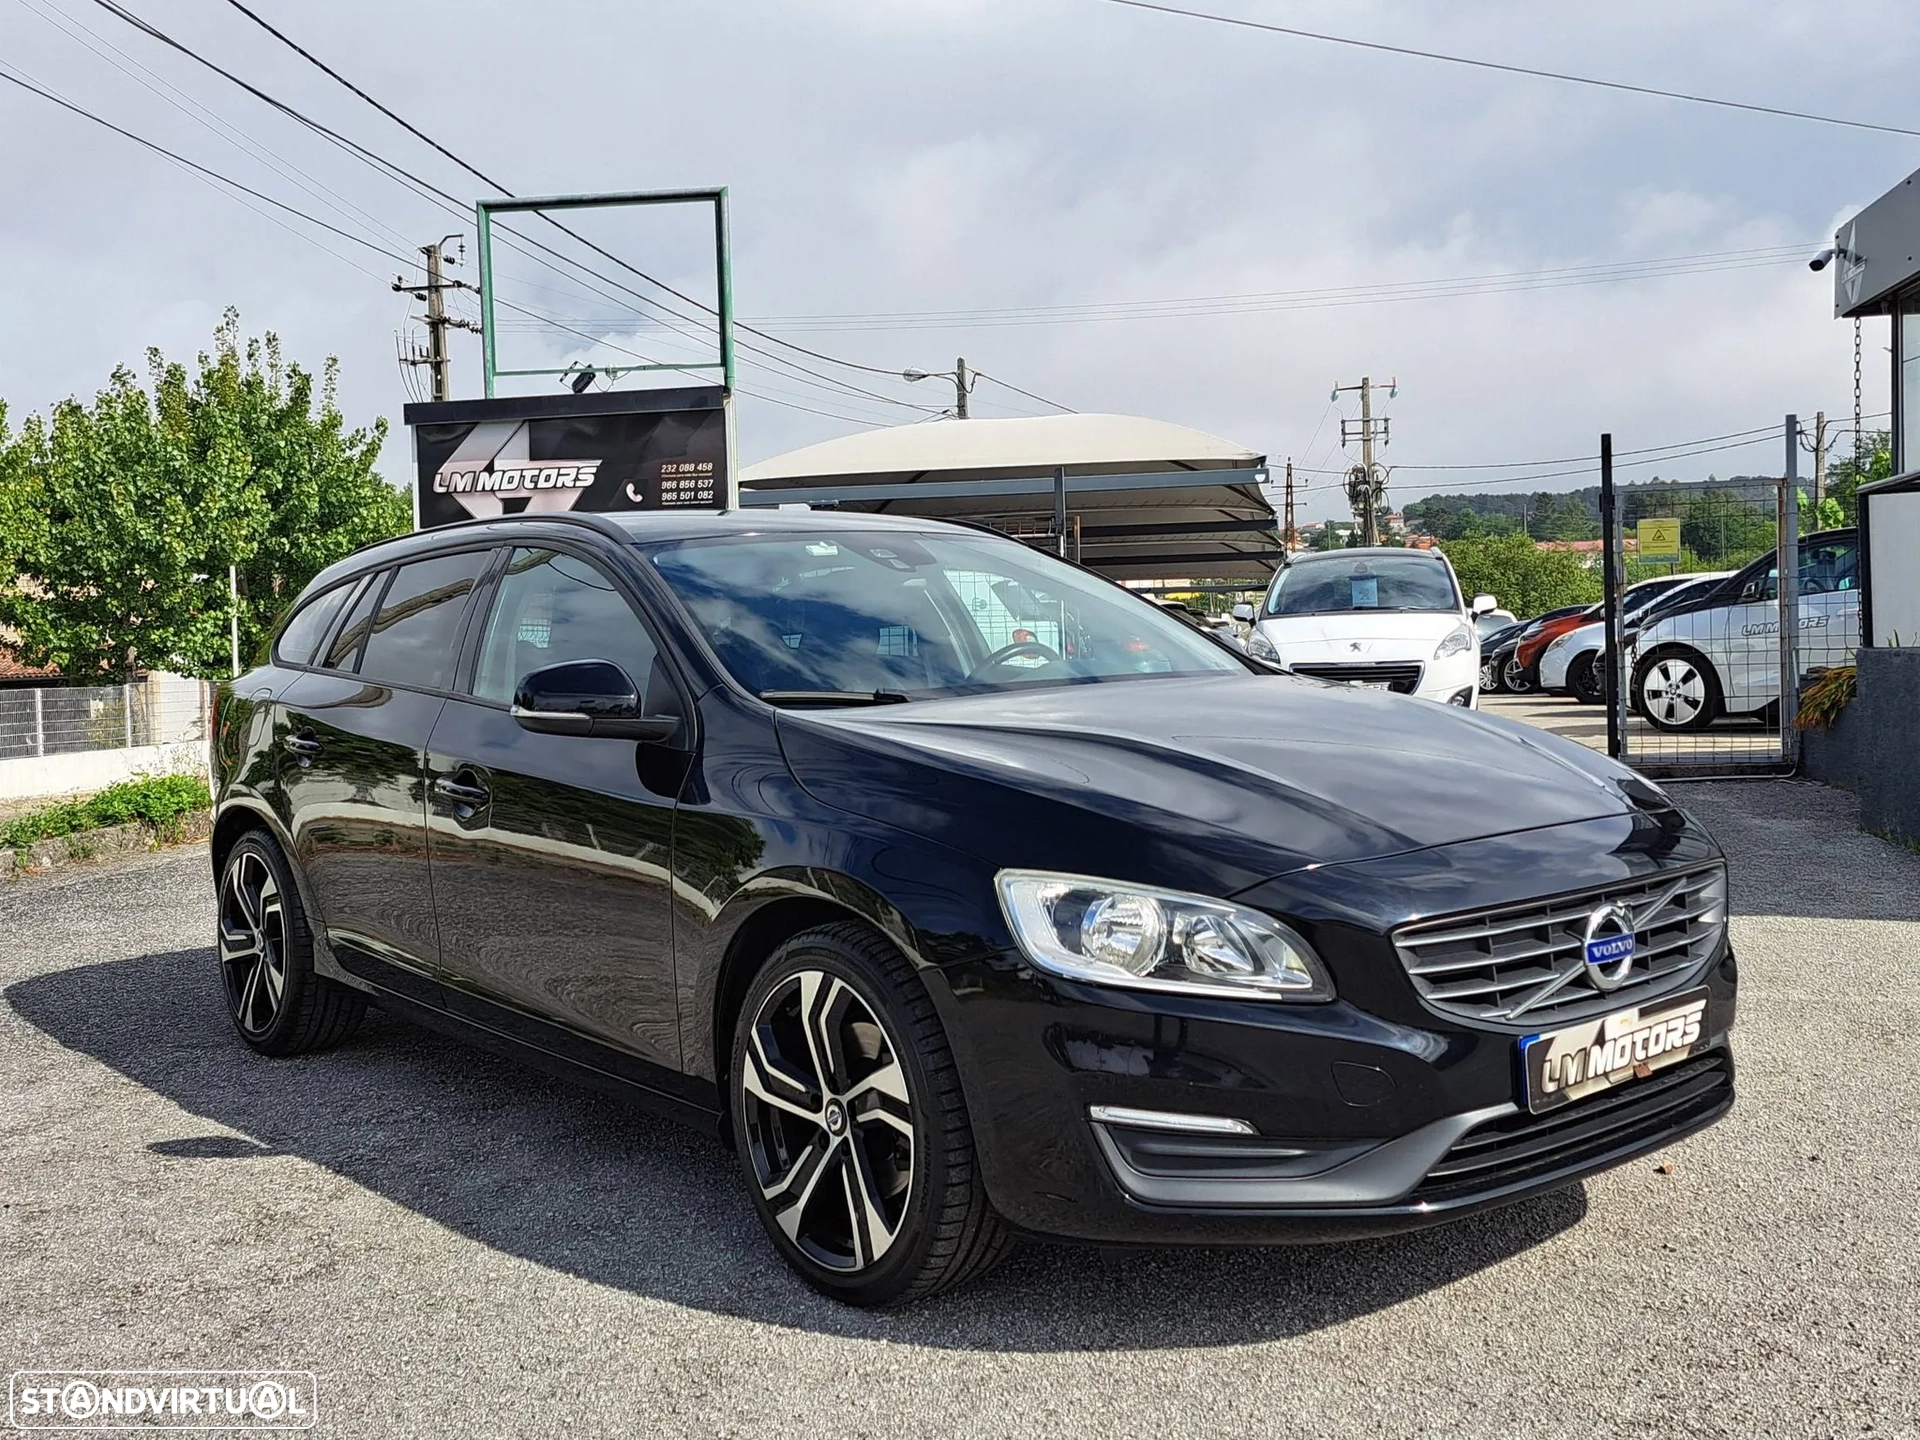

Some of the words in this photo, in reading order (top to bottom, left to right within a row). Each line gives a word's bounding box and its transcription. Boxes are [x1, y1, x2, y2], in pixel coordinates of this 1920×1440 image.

[661, 465, 677, 473] 232
[679, 463, 695, 472] 088
[697, 462, 713, 471] 458
[433, 471, 476, 493] LM
[474, 466, 598, 491] MOTORS
[661, 480, 678, 490] 966
[679, 480, 696, 489] 856
[661, 492, 677, 501] 965
[680, 491, 695, 500] 501
[697, 490, 714, 499] 082
[1765, 615, 1830, 633] MORS
[1591, 939, 1633, 958] VOLVO
[1540, 1047, 1588, 1094] LM
[1586, 1011, 1703, 1079] MOTORS
